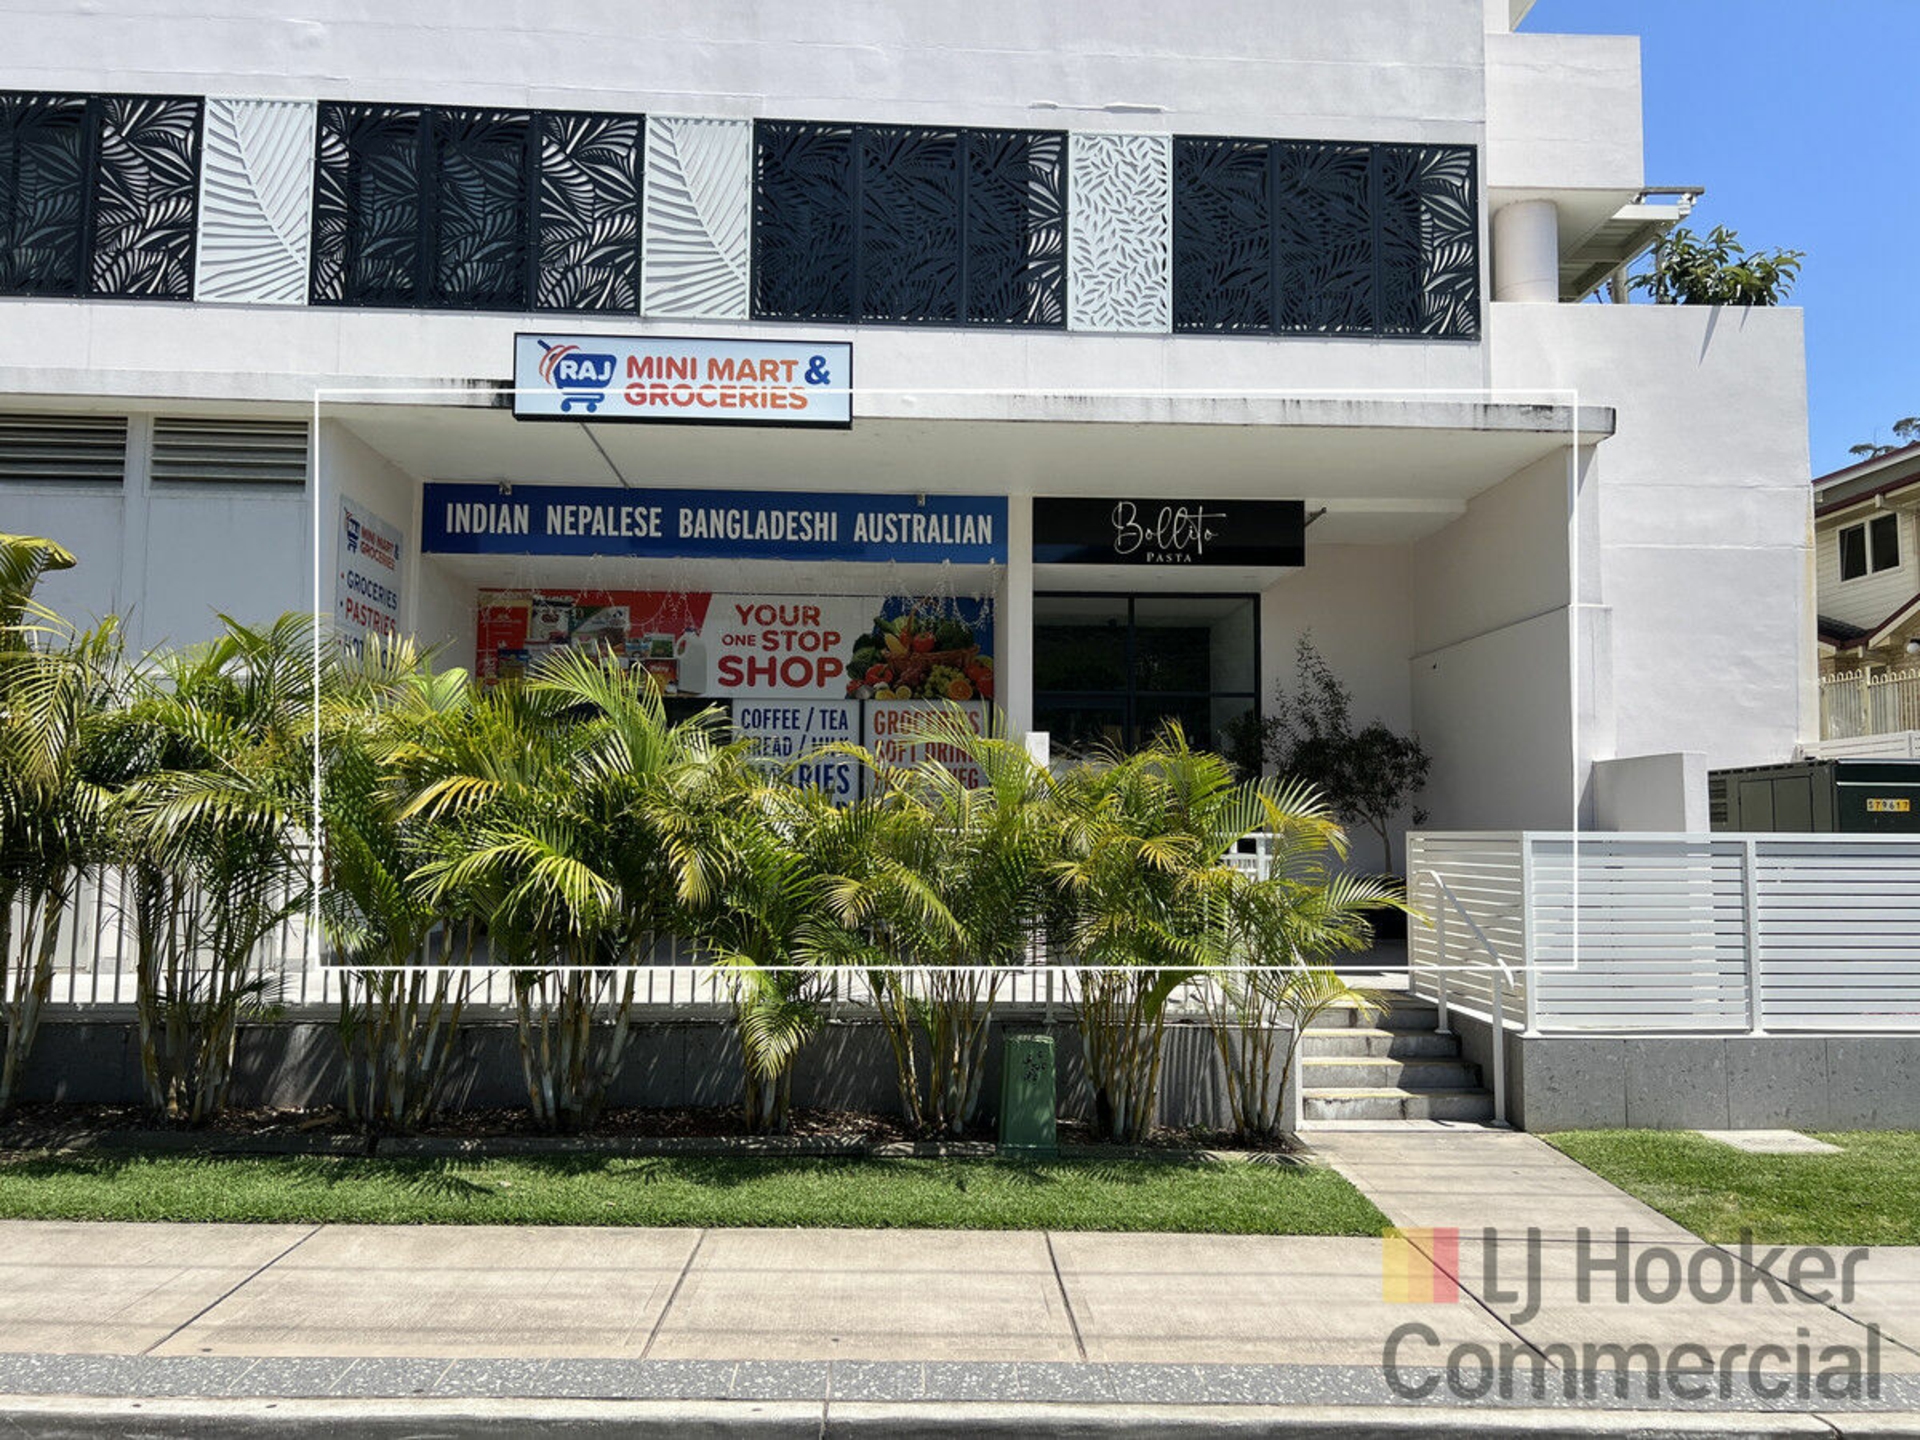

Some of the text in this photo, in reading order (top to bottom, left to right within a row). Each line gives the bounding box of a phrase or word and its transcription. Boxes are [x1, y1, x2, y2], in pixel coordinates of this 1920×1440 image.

[559, 358, 612, 382] RAJ
[626, 355, 831, 386] MINI MART &
[623, 381, 809, 410] GROCERIES
[446, 503, 993, 545] INDIAN NEPALESE BANGLADESHI AUSTRALIAN
[1111, 501, 1227, 555] Bollito
[1146, 552, 1192, 563] PASTA
[347, 570, 397, 611] GROCERIES
[346, 597, 397, 639] PASTRIES
[735, 603, 821, 627] YOUR
[722, 630, 841, 652] ONE STOP
[718, 655, 843, 688] SHOP
[741, 706, 849, 732] COFFEE / TEA
